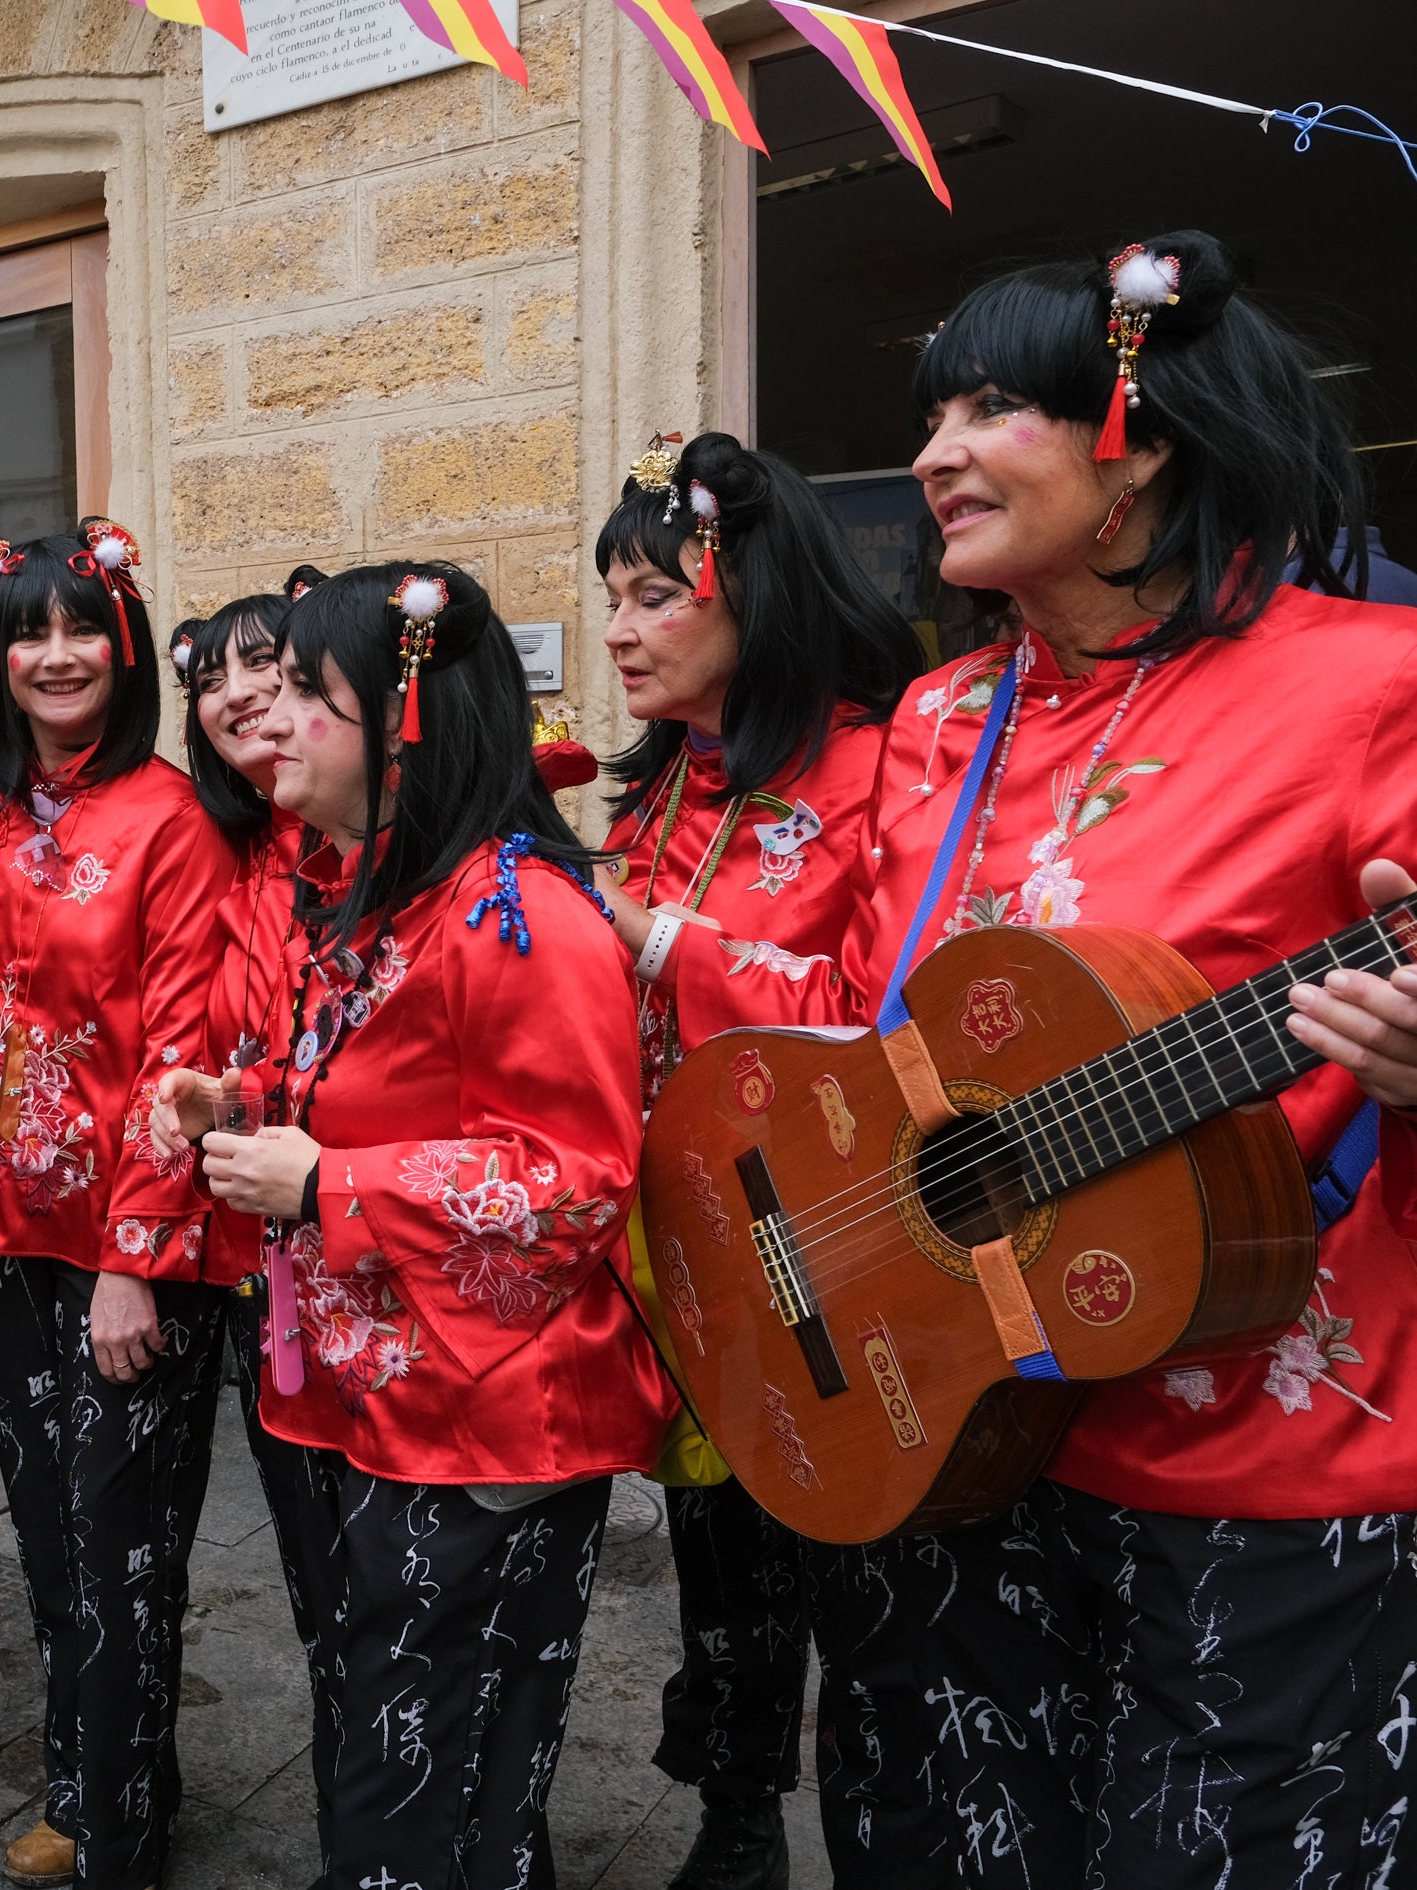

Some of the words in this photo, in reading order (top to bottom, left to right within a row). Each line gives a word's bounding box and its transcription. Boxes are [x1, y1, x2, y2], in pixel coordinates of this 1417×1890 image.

[246, 14, 287, 34] recuerdo
[289, 12, 296, 24] y
[269, 28, 296, 42] como
[299, 15, 335, 33] cantaor
[339, 0, 386, 21] flamenco
[230, 71, 253, 84] cuyo
[255, 62, 278, 77] ciclo
[332, 47, 338, 55] a
[341, 39, 350, 52] el
[250, 54, 262, 64] en
[265, 47, 274, 60] el
[277, 33, 331, 56] Centenario
[333, 27, 346, 39] de
[349, 24, 360, 35] su
[331, 61, 341, 71] de
[382, 47, 393, 57] de
